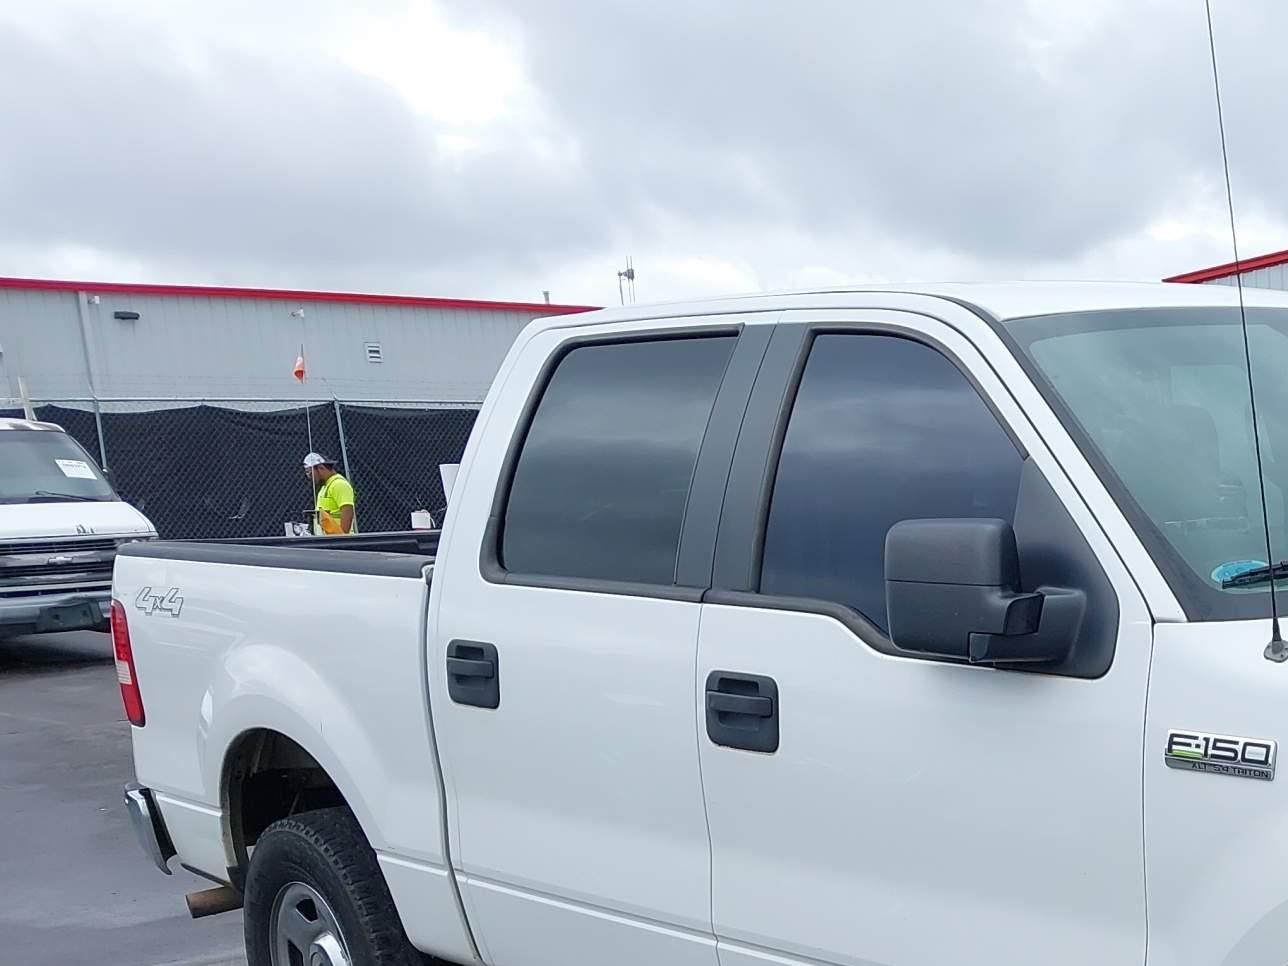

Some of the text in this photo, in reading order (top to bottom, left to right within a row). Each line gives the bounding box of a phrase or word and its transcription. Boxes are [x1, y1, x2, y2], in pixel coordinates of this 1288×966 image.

[135, 586, 184, 617] 4x4
[1167, 732, 1271, 766] F-150
[1231, 767, 1270, 779] TRITON
